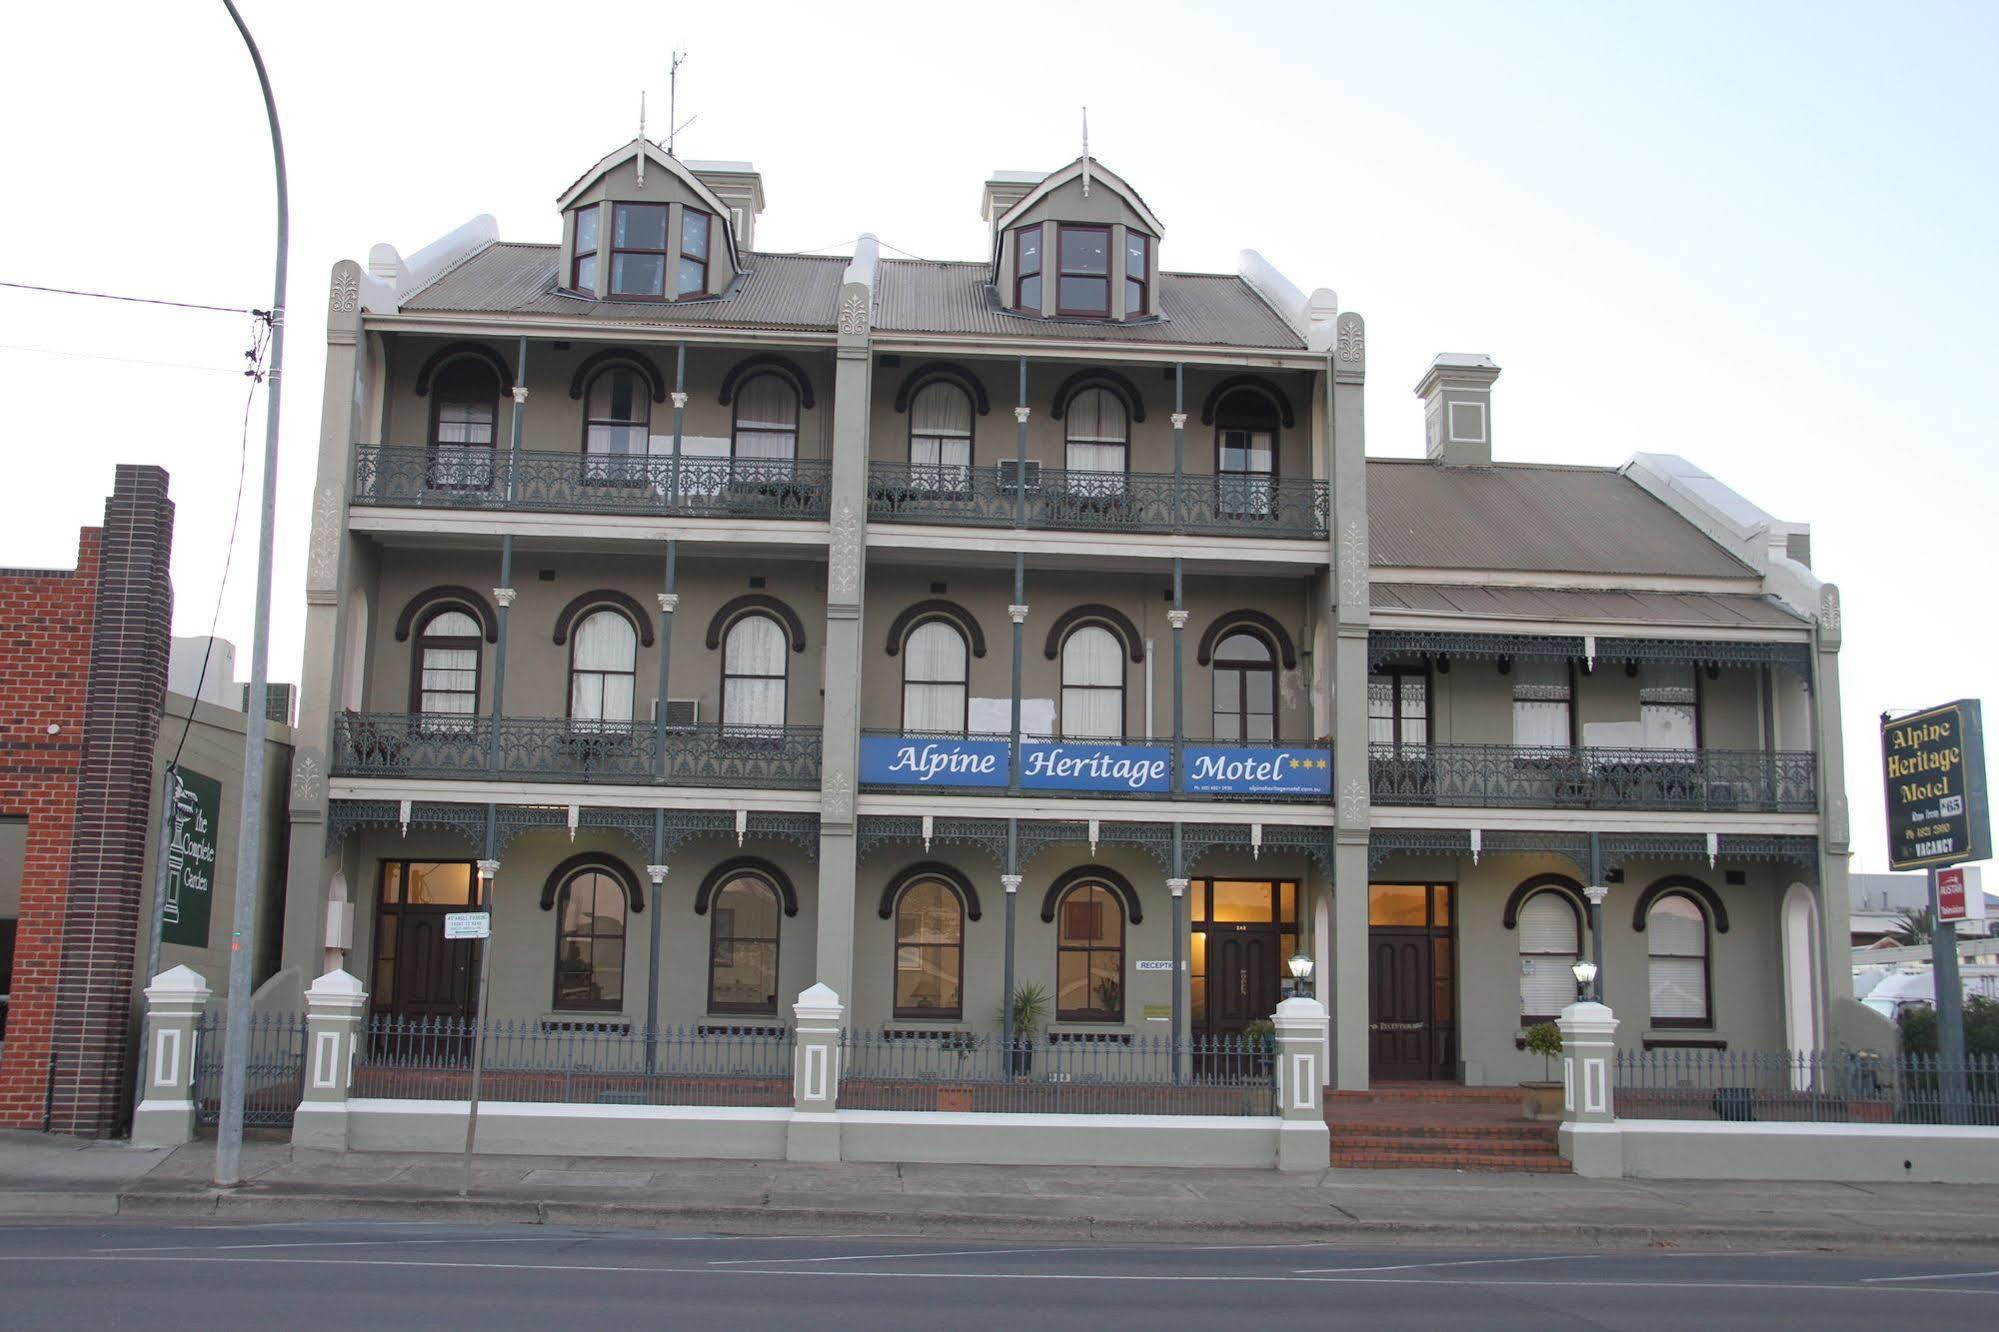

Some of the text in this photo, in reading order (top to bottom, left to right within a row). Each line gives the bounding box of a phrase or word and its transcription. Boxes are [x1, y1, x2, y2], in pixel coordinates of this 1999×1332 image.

[1892, 722, 1951, 749] Alpine
[888, 744, 1290, 788] Alpine Heritage Motel
[1888, 747, 1960, 778] Heritage
[1901, 776, 1949, 804] Motel
[182, 833, 214, 865] Complete
[1915, 838, 1953, 858] VACANCY
[184, 867, 208, 891] Garden
